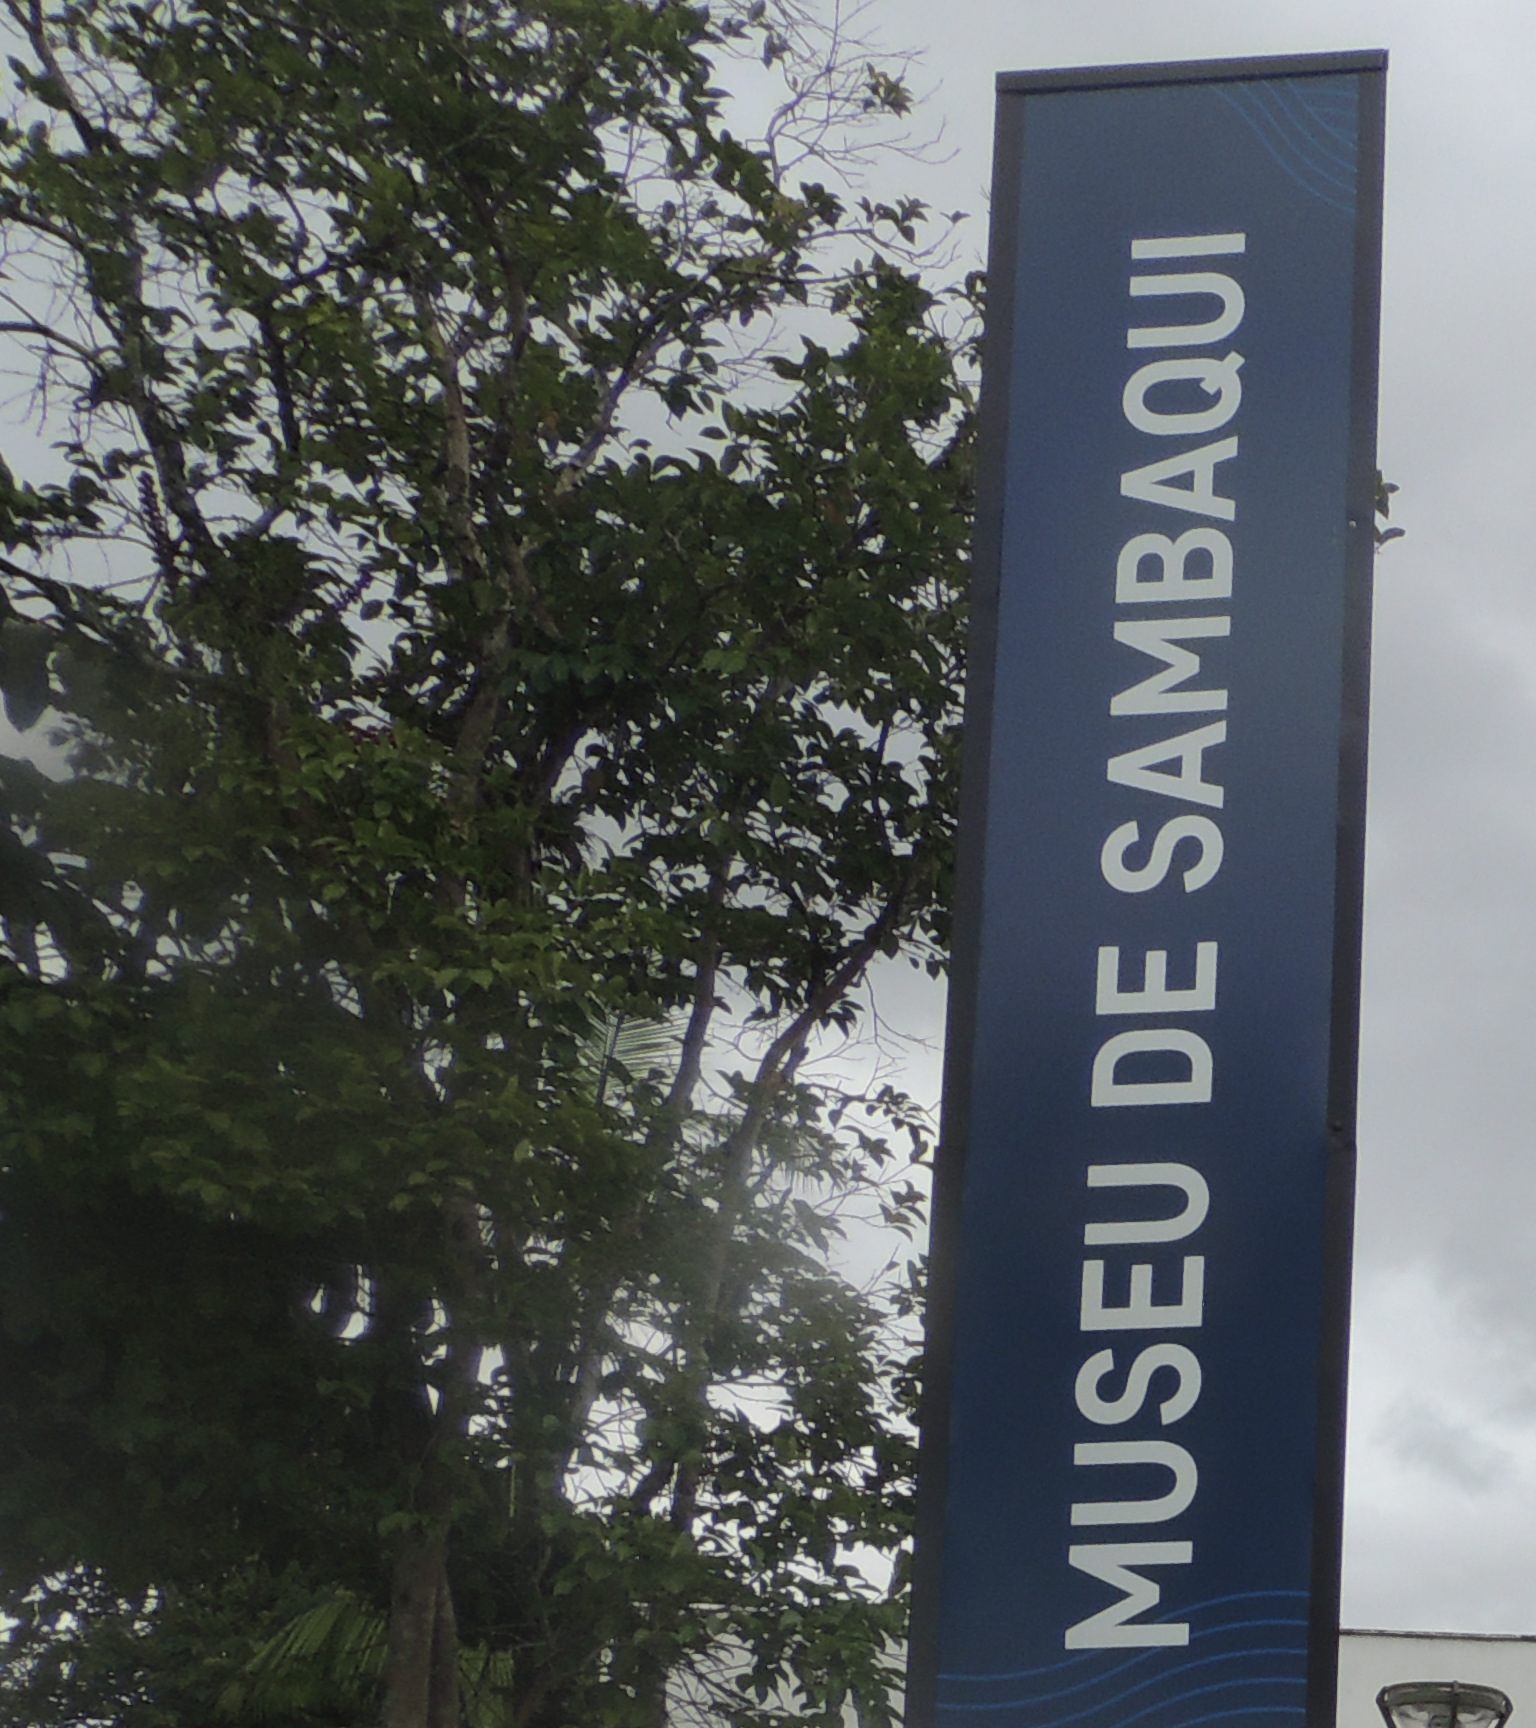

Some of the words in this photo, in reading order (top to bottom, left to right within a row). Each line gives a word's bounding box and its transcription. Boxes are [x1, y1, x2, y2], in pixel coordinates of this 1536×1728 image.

[1101, 232, 1246, 894] SAMBAQUI
[1091, 941, 1219, 1107] DE
[1065, 1161, 1210, 1650] MUSEU
